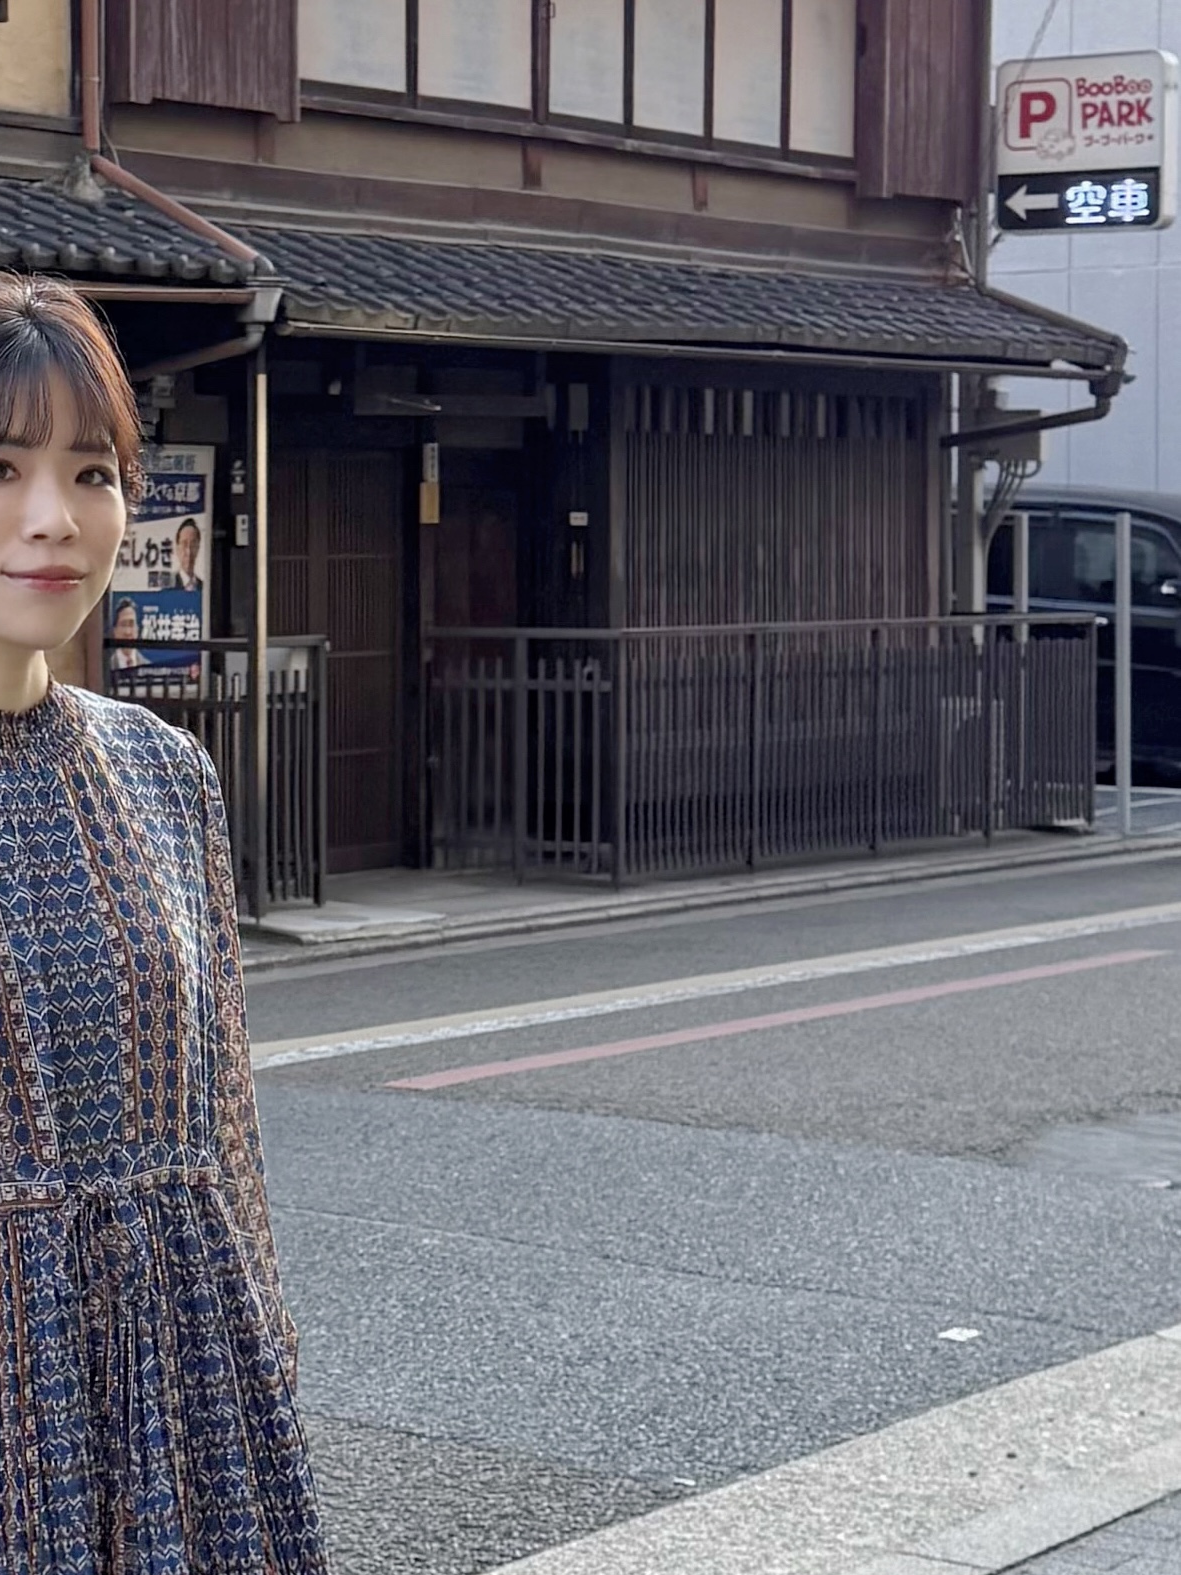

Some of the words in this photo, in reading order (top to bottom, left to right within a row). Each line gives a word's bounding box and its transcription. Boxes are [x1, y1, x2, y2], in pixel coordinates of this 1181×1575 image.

[1019, 91, 1056, 139] P
[1081, 97, 1154, 129] PARK
[1065, 178, 1150, 225] 空車
[115, 537, 173, 569] にしわき
